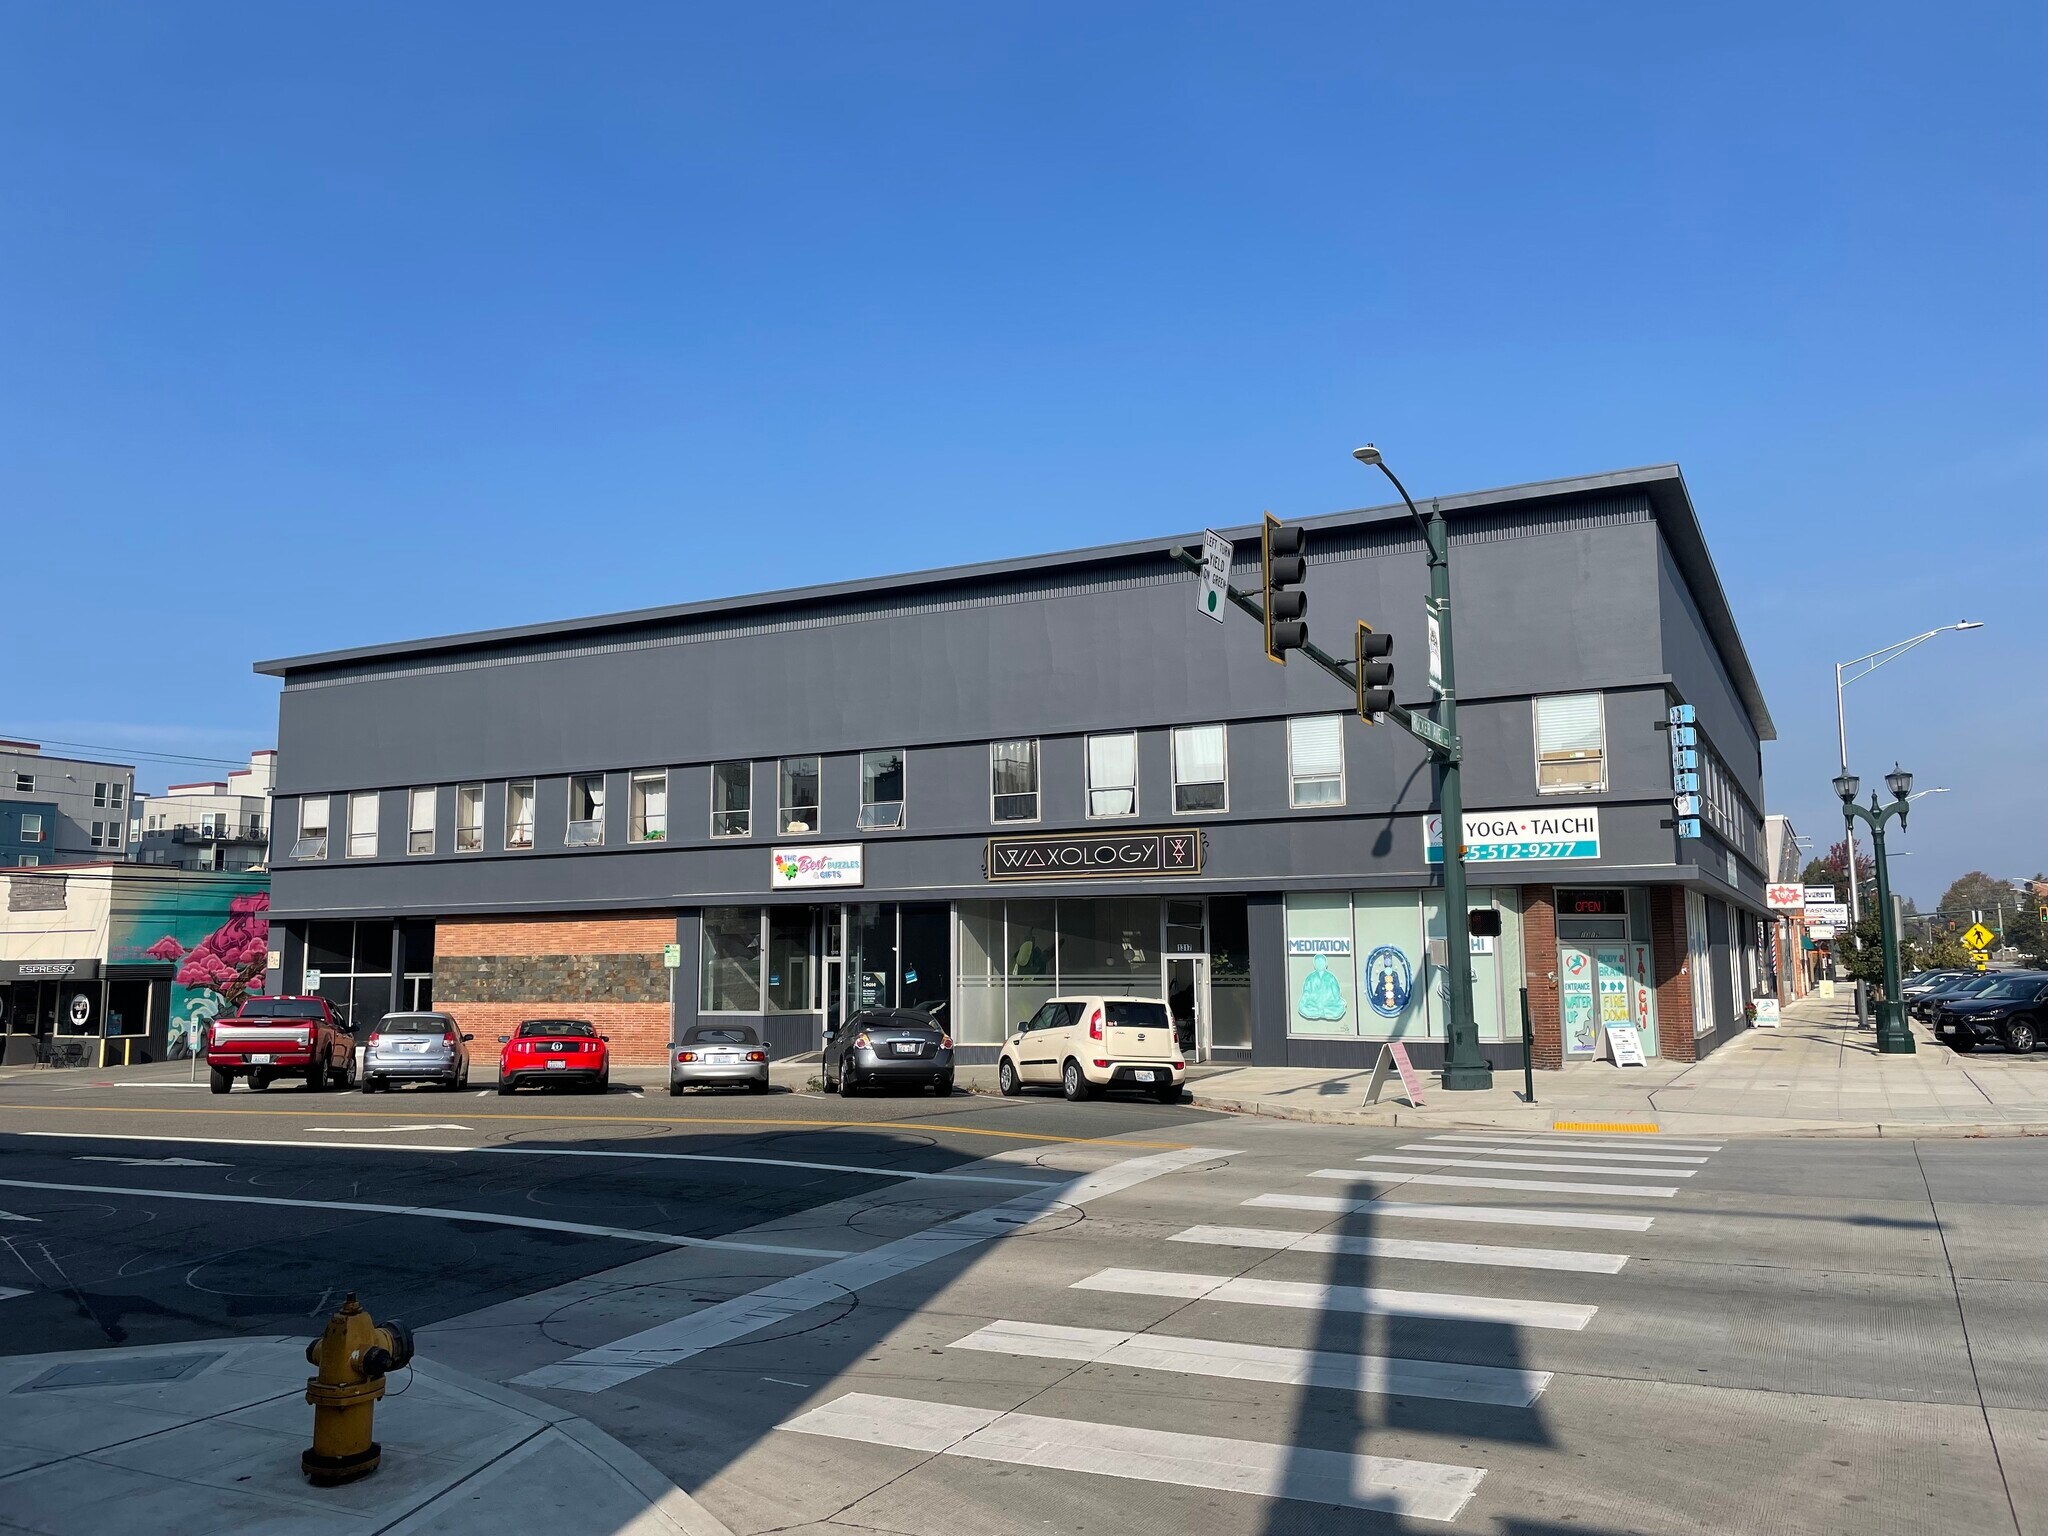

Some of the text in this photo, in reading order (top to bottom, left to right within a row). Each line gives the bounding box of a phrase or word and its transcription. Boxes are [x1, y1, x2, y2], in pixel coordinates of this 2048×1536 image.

[1206, 534, 1231, 558] LEFT TURN
[1209, 552, 1225, 573] YIELD
[1413, 714, 1442, 743] RUCKER AVE
[1466, 821, 1519, 838] YOGA
[997, 844, 1155, 868] WAXOLOGY
[798, 855, 832, 873] Best
[827, 860, 859, 869] PUZZLES
[820, 871, 842, 879] GIFTS
[1575, 901, 1601, 912] OPEN
[1289, 939, 1350, 952] MEDITATION
[1598, 954, 1625, 963] BODY &
[19, 965, 75, 973] ESPRESSO
[1599, 966, 1625, 977] BRAIN
[1565, 982, 1590, 992] ENTRANCE
[1565, 995, 1591, 1009] WATER
[1603, 995, 1626, 1008] FIRE
[1602, 1008, 1629, 1022] DOWN
[1638, 989, 1648, 1029] CHI
[1566, 1010, 1579, 1024] UP
